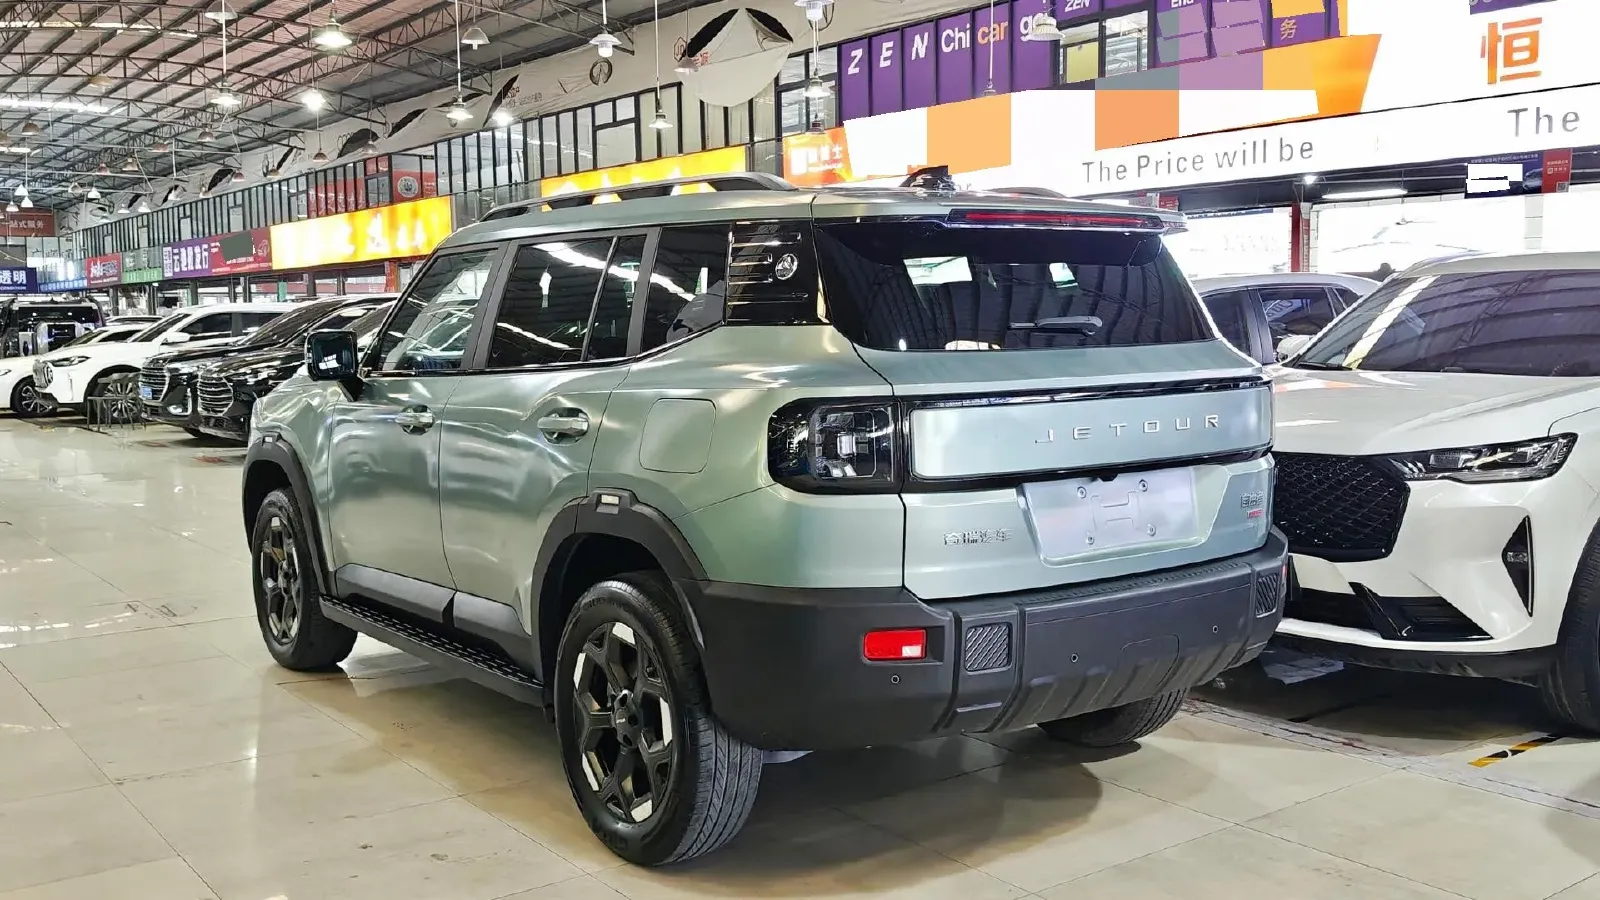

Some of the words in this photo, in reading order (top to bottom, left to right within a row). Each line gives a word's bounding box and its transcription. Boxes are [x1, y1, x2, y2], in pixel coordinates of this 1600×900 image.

[941, 28, 970, 53] Chi
[977, 20, 1008, 45] car
[1280, 19, 1297, 40] 务
[1480, 17, 1543, 84] 恒
[1507, 106, 1580, 137] The
[1082, 160, 1127, 183] The
[1137, 151, 1204, 178] Price
[1215, 139, 1267, 168] will
[1279, 137, 1314, 162] be
[0, 269, 26, 285] 透明
[1035, 414, 1219, 444] JETOUR
[943, 528, 1013, 546] 奇瑞汽车
